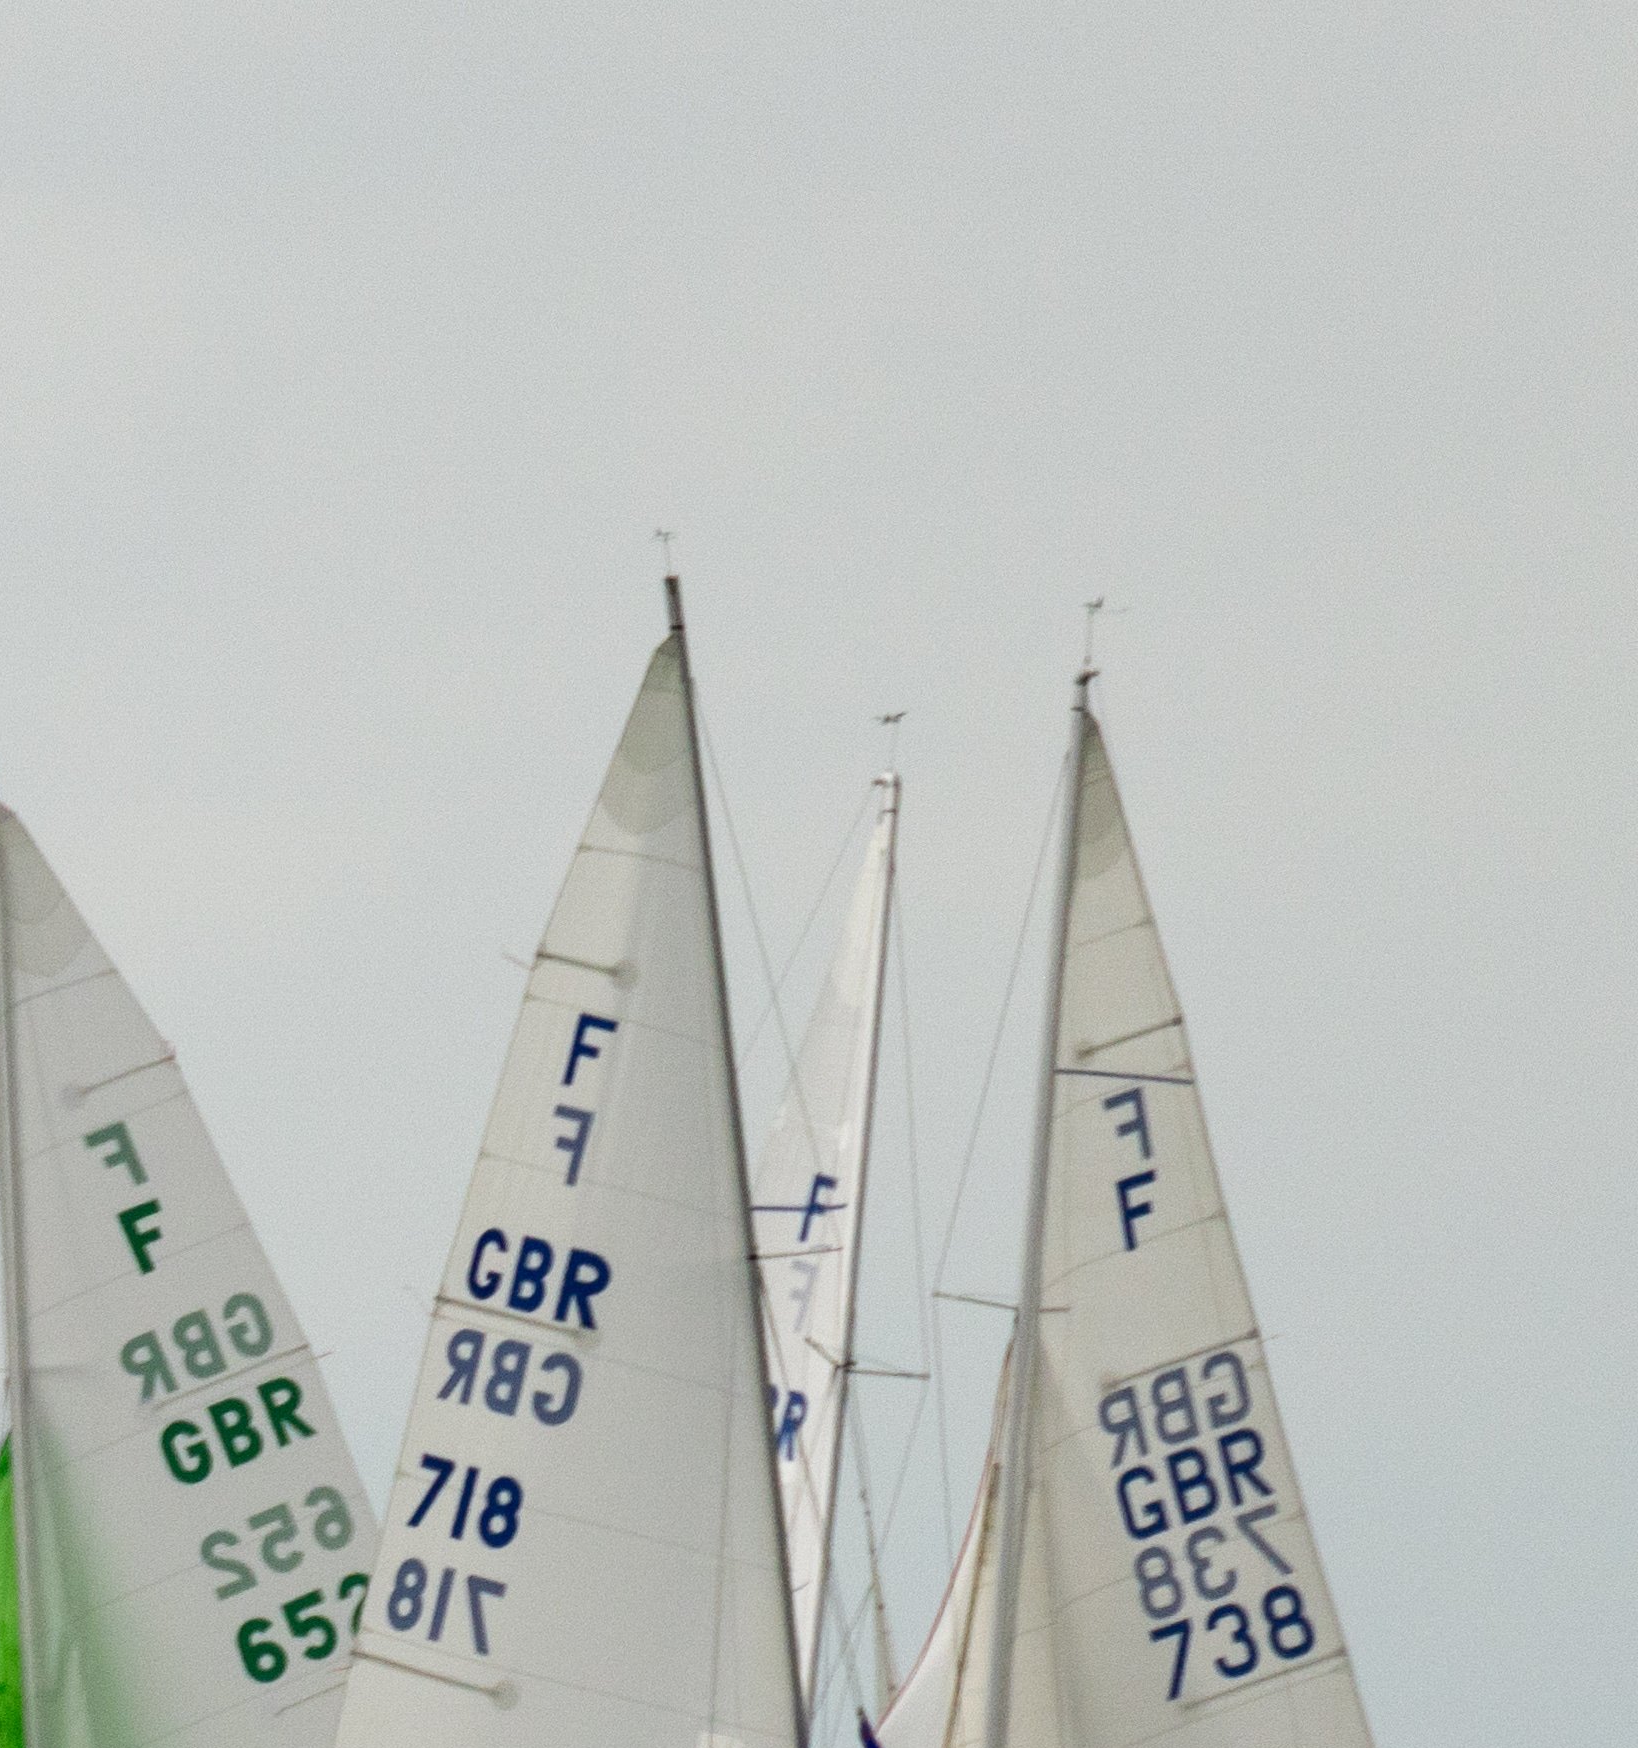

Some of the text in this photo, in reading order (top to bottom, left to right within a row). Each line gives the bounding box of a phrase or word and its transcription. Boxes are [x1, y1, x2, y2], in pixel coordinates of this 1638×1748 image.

[562, 1013, 619, 1086] F
[118, 1199, 163, 1275] F
[799, 1173, 838, 1242] F
[1115, 1170, 1156, 1251] F
[466, 1228, 611, 1330] GBR
[159, 1375, 317, 1485] GBR
[407, 1453, 524, 1549] 718
[1117, 1427, 1273, 1542] GBR
[1149, 1584, 1316, 1701] 738
